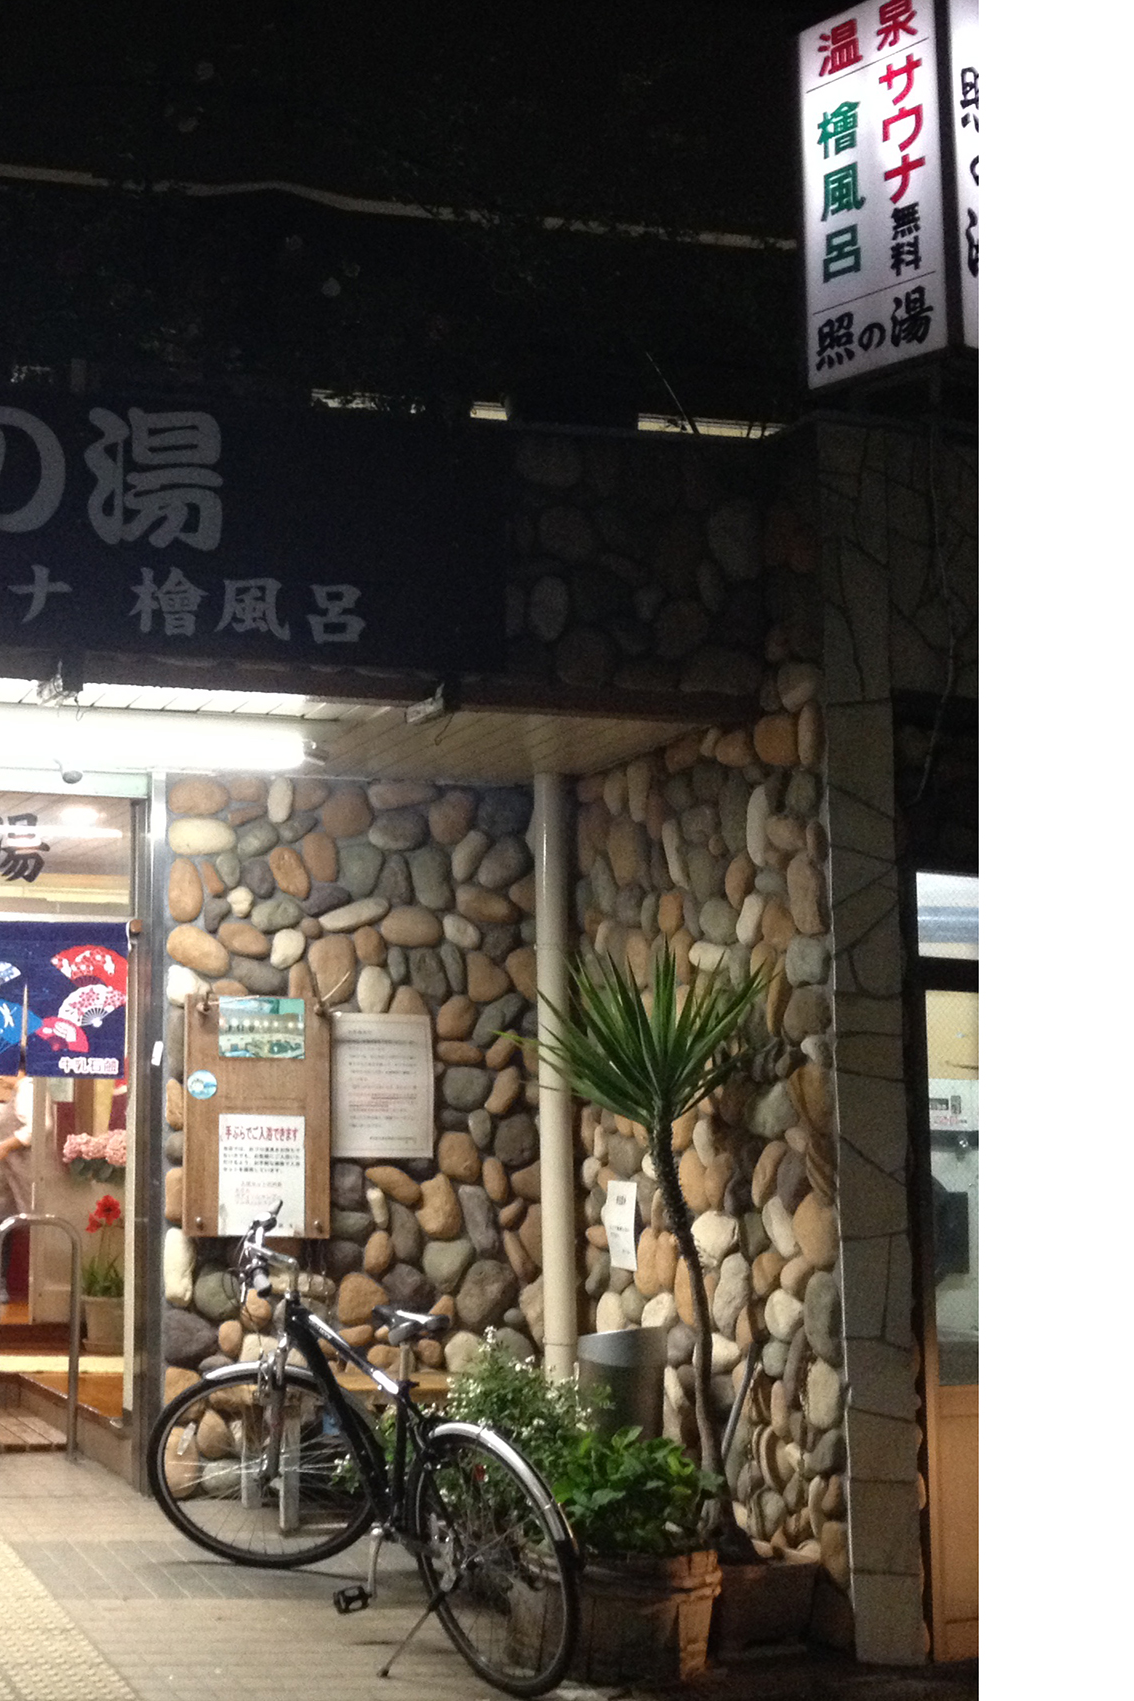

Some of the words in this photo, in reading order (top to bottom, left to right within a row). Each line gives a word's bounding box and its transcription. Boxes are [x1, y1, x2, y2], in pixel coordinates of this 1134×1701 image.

[817, 0, 918, 77] 温泉
[817, 100, 866, 284] 檜風呂
[816, 285, 933, 371] 照の湯
[129, 566, 367, 646] 檜風呂
